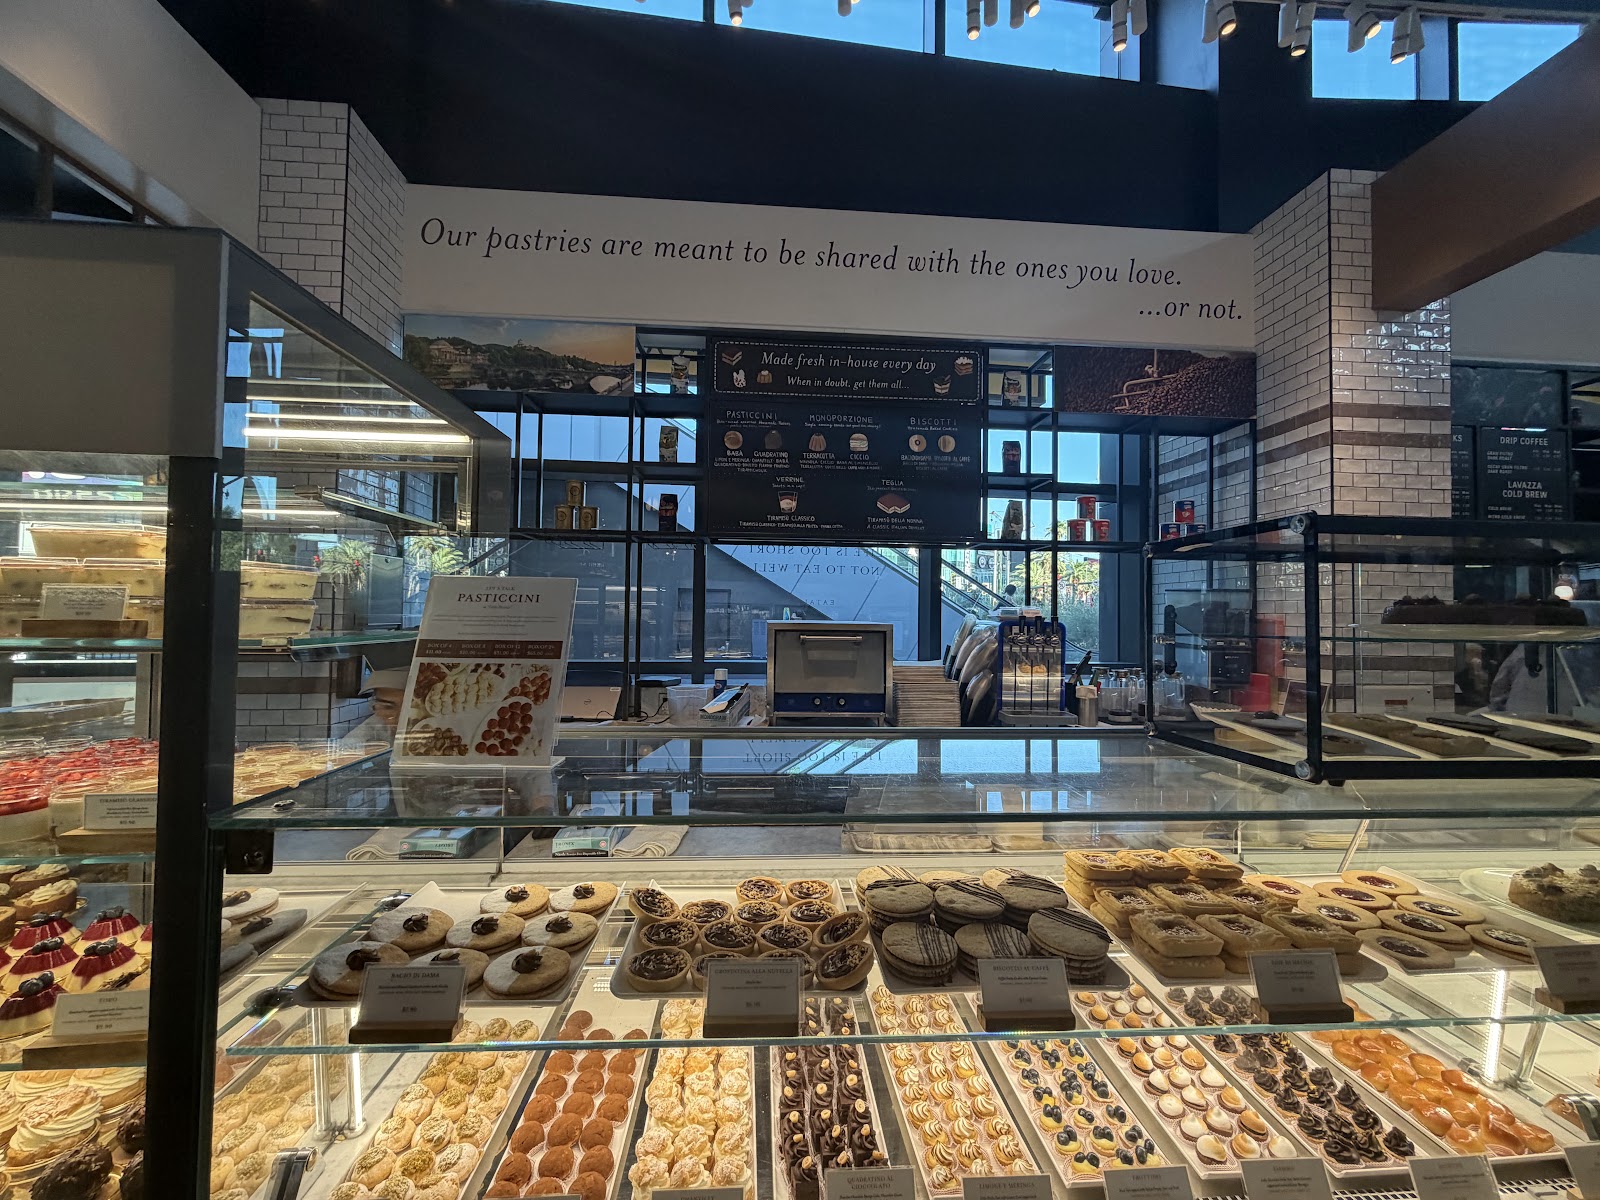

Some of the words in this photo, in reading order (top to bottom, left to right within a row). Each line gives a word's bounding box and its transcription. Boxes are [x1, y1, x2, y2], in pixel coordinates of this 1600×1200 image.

[421, 217, 477, 247] Our
[483, 226, 591, 259] pastries
[602, 236, 643, 257] are
[654, 238, 735, 262] meant
[745, 240, 768, 264] to
[780, 238, 805, 266] be
[815, 241, 898, 271] shared
[907, 249, 959, 275] with
[969, 249, 1006, 277] the
[1016, 262, 1067, 281] ones
[1066, 264, 1117, 290] you
[1127, 258, 1182, 286] love.
[1138, 300, 1189, 318] ...or
[1198, 300, 1242, 320] not.
[761, 351, 794, 365] Made
[795, 353, 825, 370] fresh
[829, 355, 879, 369] in-house
[882, 360, 913, 374] every
[916, 357, 937, 375] day
[786, 375, 811, 386] When
[814, 376, 822, 386] in
[852, 380, 866, 391] get
[868, 379, 889, 389] them
[726, 410, 778, 420] PASTICCINI
[809, 414, 873, 424] MONOPORZIONE
[910, 416, 957, 426] BISCOTTI
[1499, 436, 1517, 445] DRIP
[1519, 437, 1549, 446] COFFEE
[881, 479, 904, 487] TEGLIA
[1507, 480, 1543, 490] LAVAZZA
[1502, 489, 1523, 498] COLD
[1525, 490, 1548, 499] BREW
[457, 593, 541, 604] PASTICCINI
